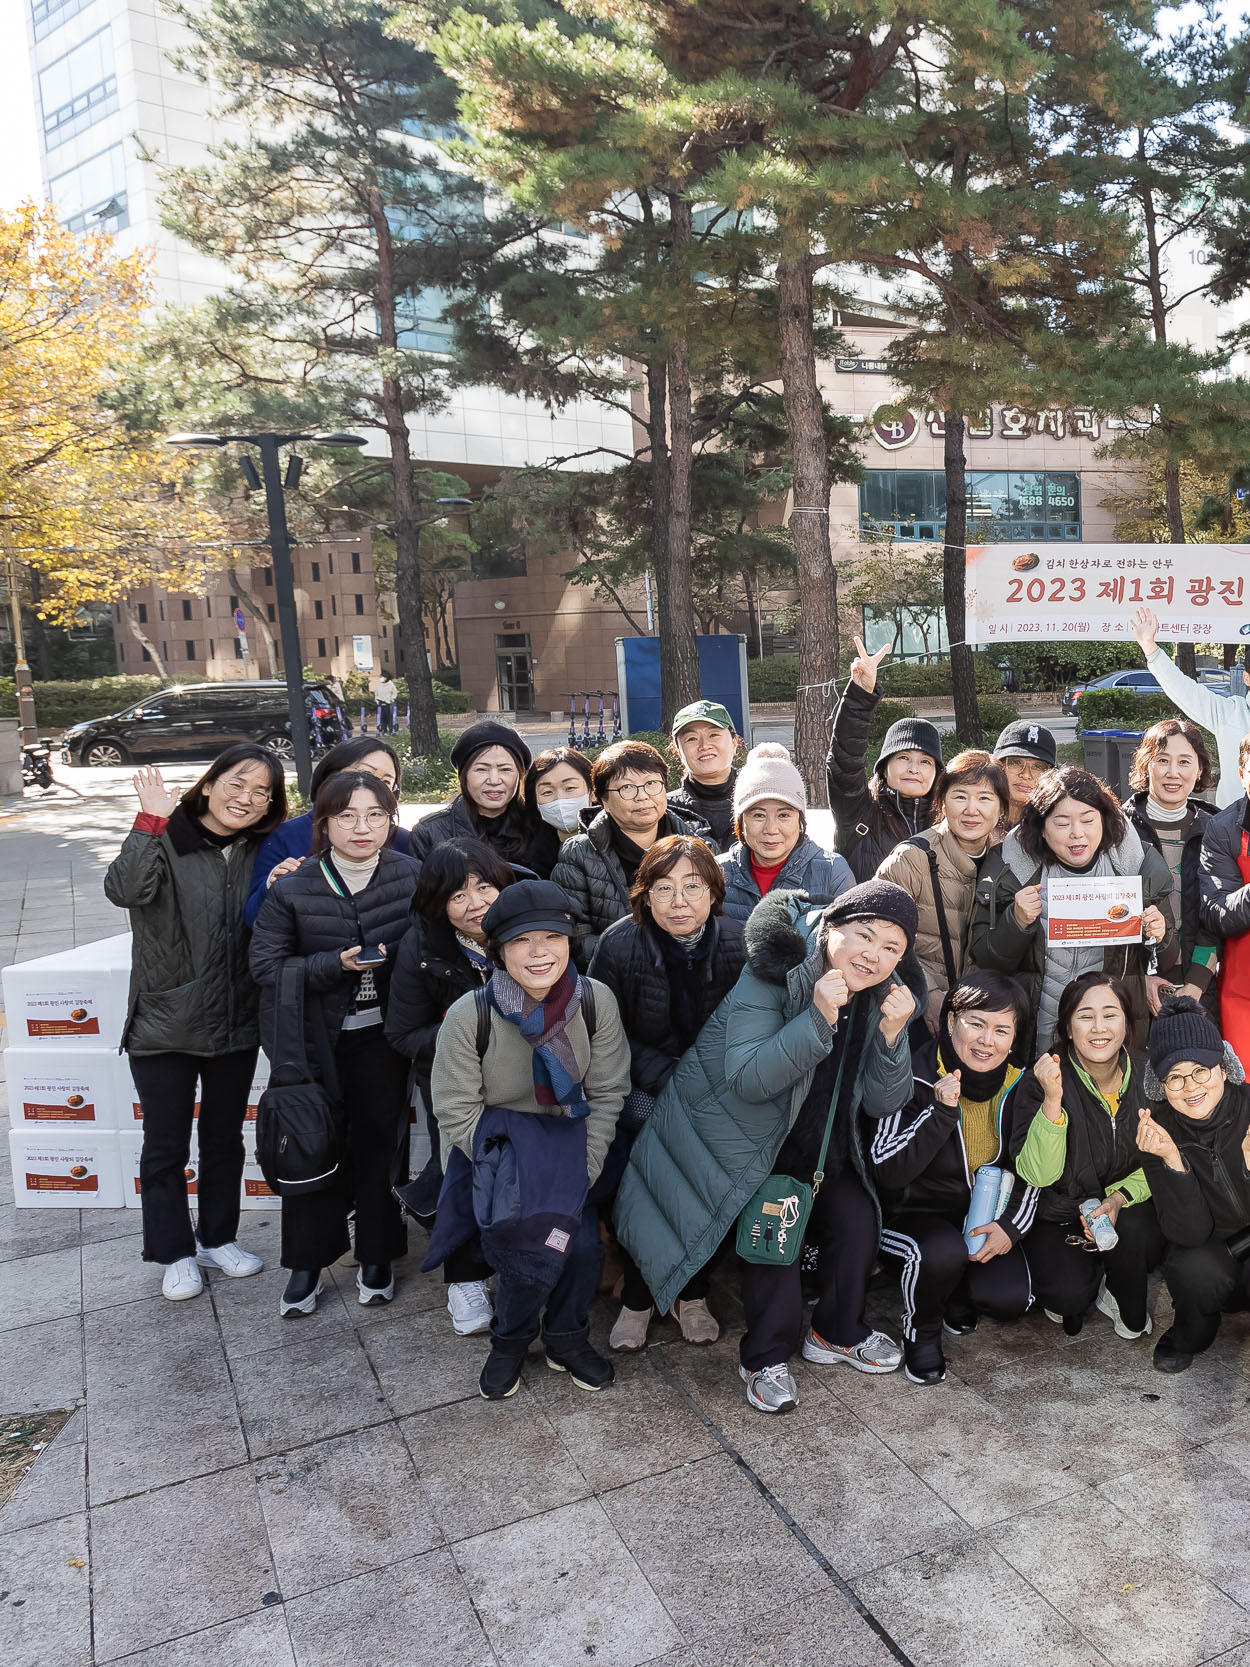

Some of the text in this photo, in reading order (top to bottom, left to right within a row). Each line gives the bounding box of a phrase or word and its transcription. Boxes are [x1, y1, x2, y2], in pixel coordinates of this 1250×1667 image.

[1020, 496, 1075, 506] 1688 4650
[1046, 559, 1174, 569] 김치 한상자로 전하는 안부
[1005, 578, 1086, 603] 2023
[1096, 576, 1175, 605] 제1회
[1185, 577, 1244, 607] 광진
[988, 624, 997, 633] 일
[1000, 624, 1008, 633] 시
[1017, 624, 1043, 632] 2023.
[1062, 622, 1090, 633] 20(월)
[1102, 622, 1110, 632] 장
[1114, 623, 1123, 631] 소
[1192, 624, 1212, 634] 광장
